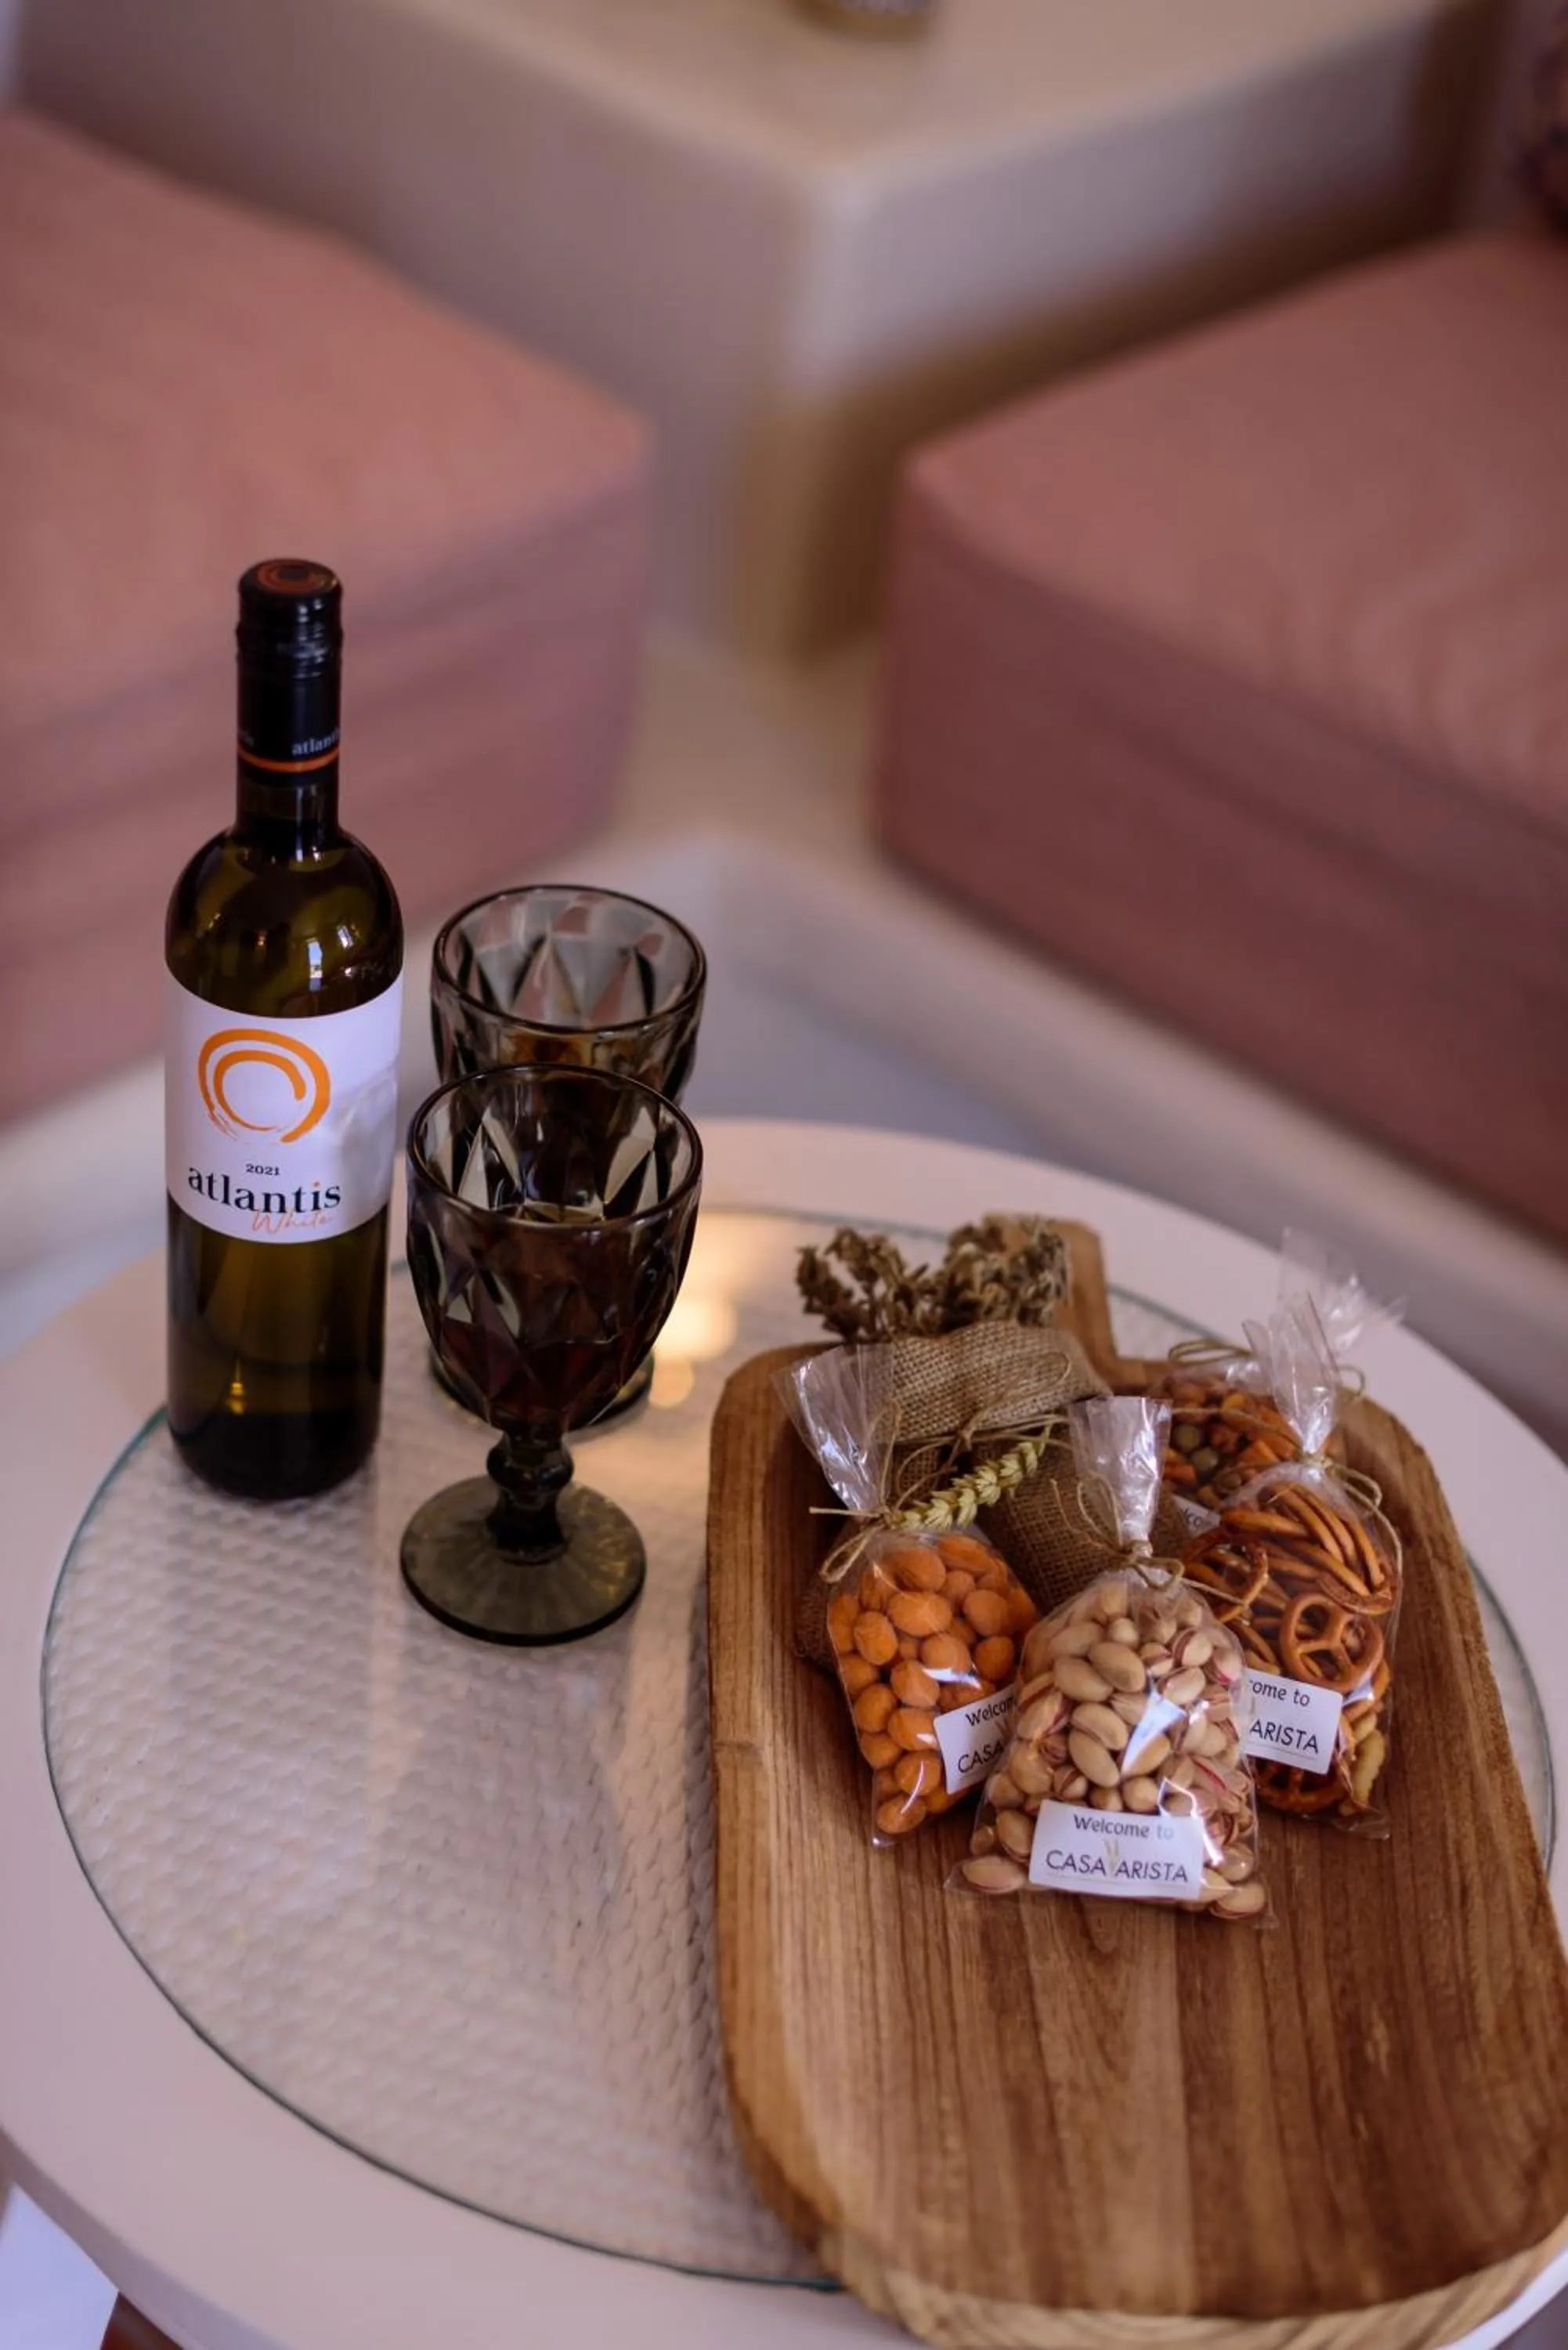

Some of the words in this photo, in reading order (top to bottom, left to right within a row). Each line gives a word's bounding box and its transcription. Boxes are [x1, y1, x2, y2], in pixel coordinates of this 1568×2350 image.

[245, 1163, 280, 1176] 2021
[187, 1166, 341, 1213] atlantis
[251, 1209, 332, 1234] White
[965, 1696, 1017, 1726] Welcom
[1293, 1688, 1310, 1706] to
[1249, 1719, 1319, 1754] ARISTA
[958, 1740, 1006, 1773] CASA
[1073, 1813, 1150, 1838] Welcome
[1156, 1824, 1174, 1839] to
[1046, 1849, 1107, 1876] CASA
[1115, 1860, 1189, 1882] ARISTA
